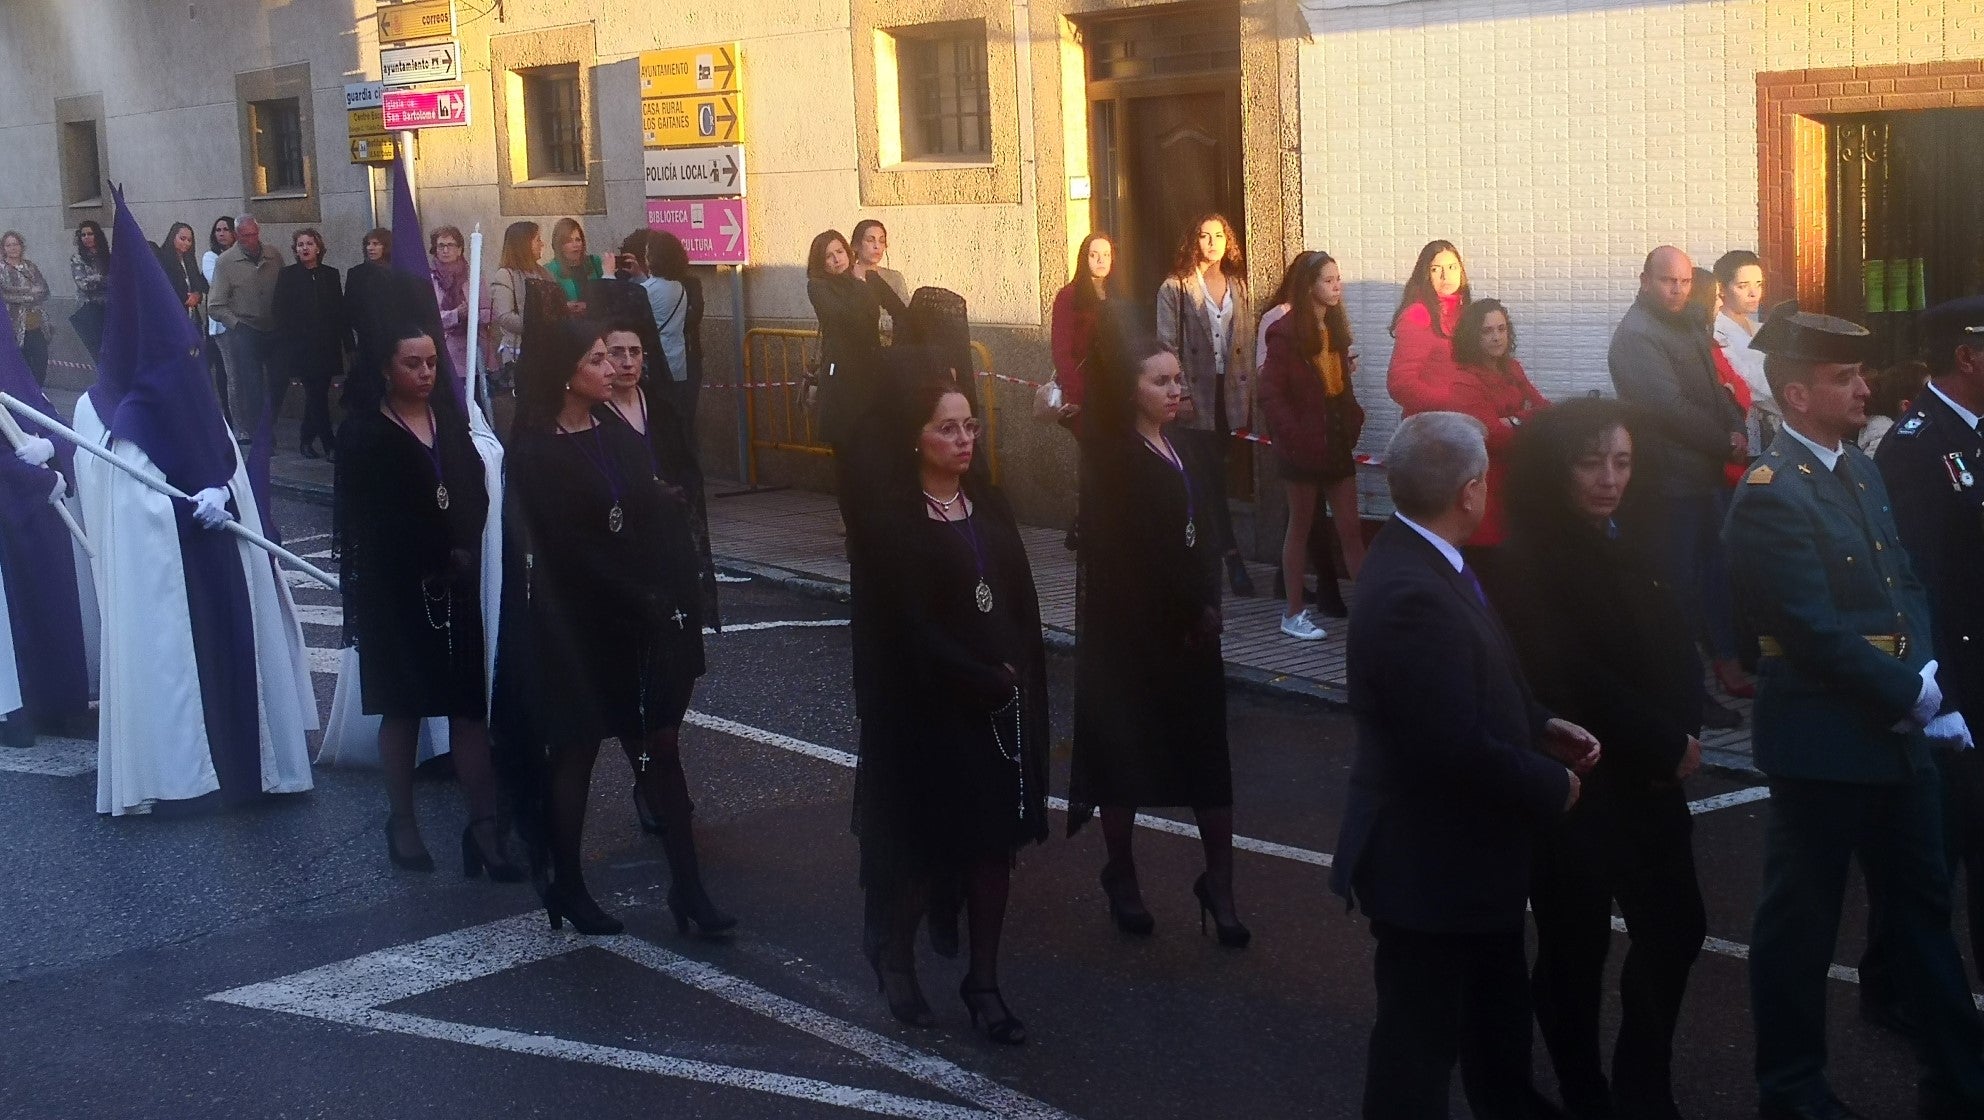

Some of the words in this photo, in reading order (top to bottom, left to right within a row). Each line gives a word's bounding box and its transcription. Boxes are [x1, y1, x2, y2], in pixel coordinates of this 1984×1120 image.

[422, 13, 449, 25] correos
[383, 58, 430, 76] ayuntamiento
[641, 62, 689, 78] AYUNTAMIENTO
[346, 87, 372, 106] guardia
[642, 102, 660, 116] CASA
[661, 101, 685, 115] RURAL
[643, 117, 656, 130] LOS
[658, 115, 690, 129] GAITANES
[646, 162, 678, 181] POLICÍA
[681, 164, 708, 180] LOCAL
[649, 210, 689, 224] BIBLIOTECA
